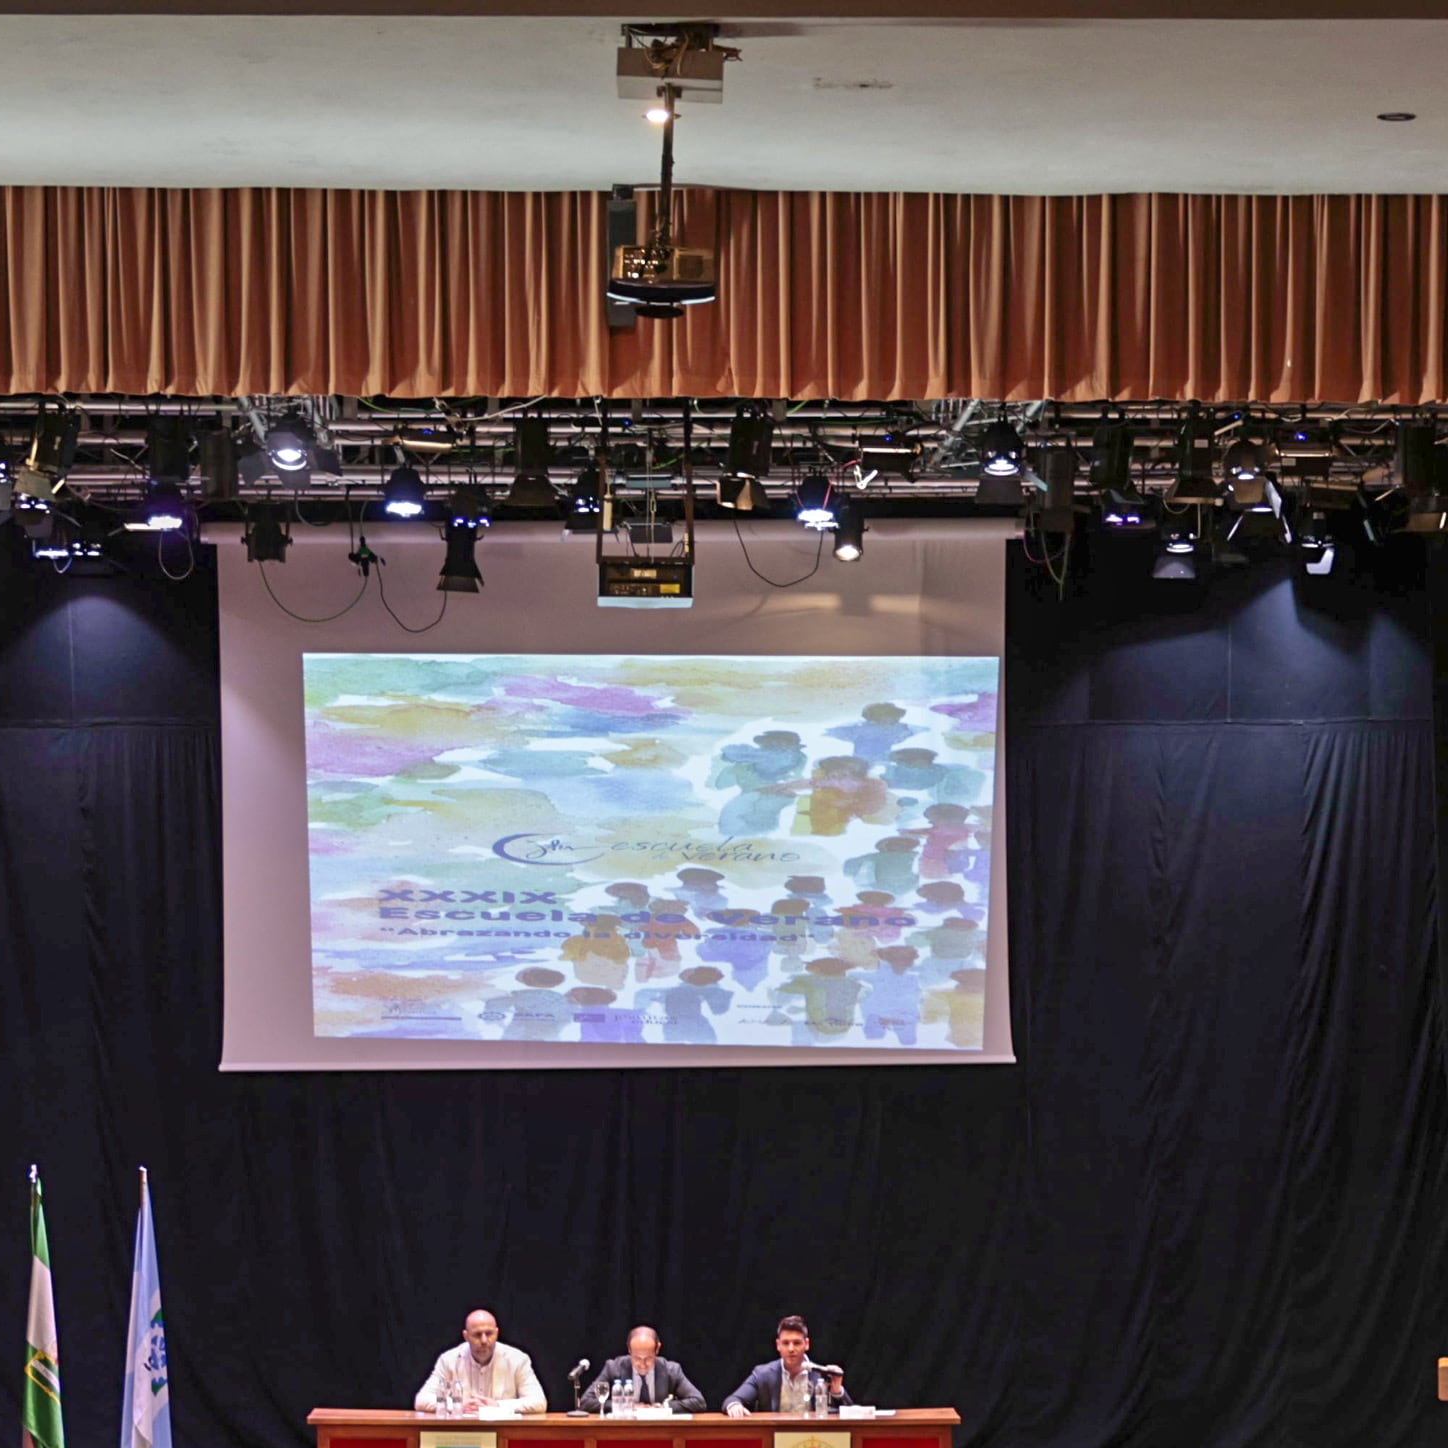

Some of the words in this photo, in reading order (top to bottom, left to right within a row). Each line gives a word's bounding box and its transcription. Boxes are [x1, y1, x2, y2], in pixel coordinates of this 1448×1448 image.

[378, 889, 558, 905] XXXIX
[378, 906, 598, 923] Escuela
[620, 910, 687, 924] de
[709, 912, 918, 928] Verano
